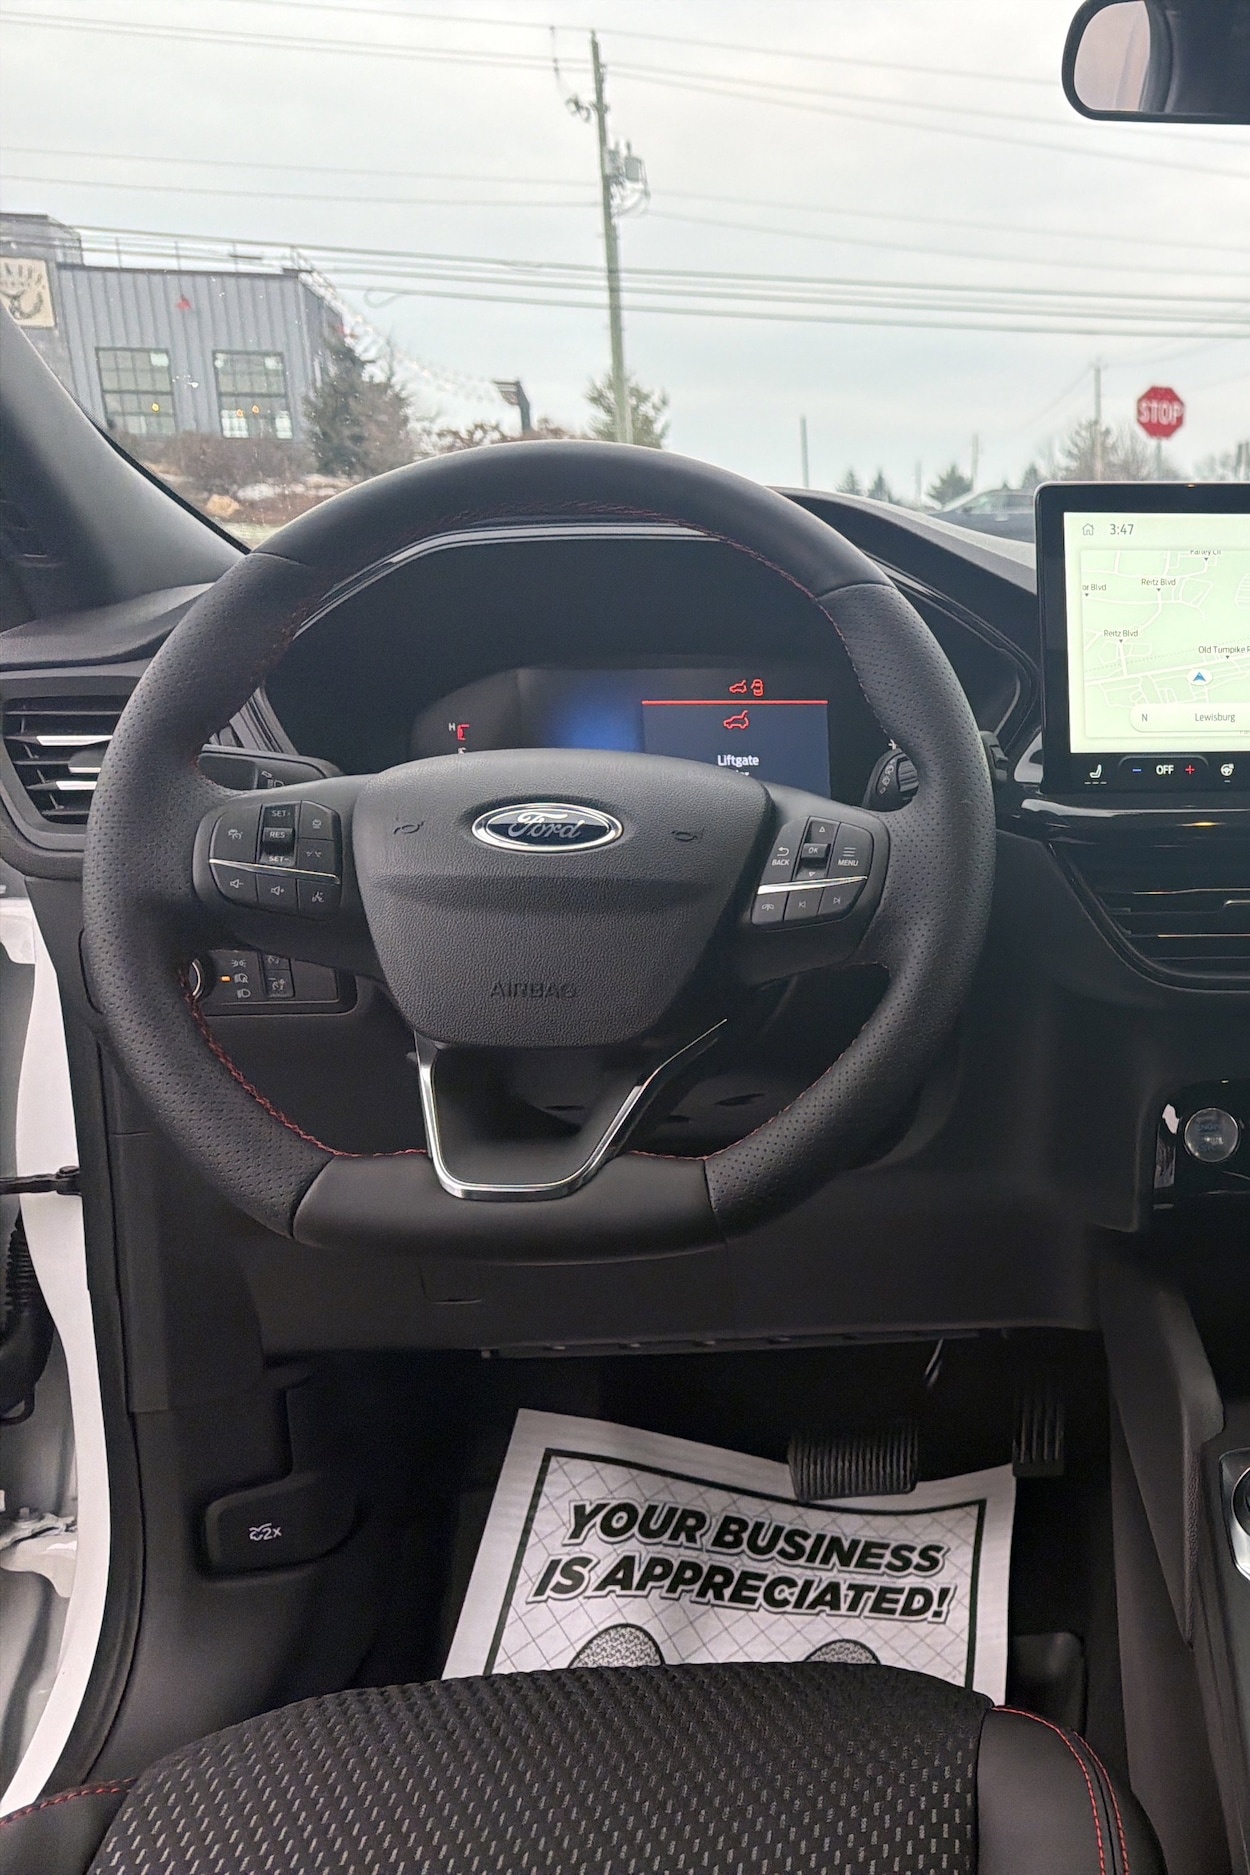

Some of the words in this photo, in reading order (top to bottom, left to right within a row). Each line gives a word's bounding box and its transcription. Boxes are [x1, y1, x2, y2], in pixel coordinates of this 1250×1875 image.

[1139, 400, 1184, 425] STOP
[1109, 523, 1134, 536] 3:47
[1090, 583, 1107, 591] Blvd
[1160, 578, 1176, 586] Blvd
[1122, 629, 1139, 637] Blvd
[1198, 646, 1212, 654] Old
[1212, 646, 1245, 656] Turnpike
[1141, 713, 1148, 722] N
[1194, 712, 1236, 723] Lewisburg
[717, 754, 760, 768] Liftgate
[1156, 764, 1174, 775] OFF
[508, 811, 585, 840] Ford
[269, 831, 286, 839] RES
[837, 859, 859, 867] MENU
[490, 982, 577, 999] AIRBAG
[566, 1500, 707, 1547] YOUR
[711, 1515, 948, 1576] BUSINESS
[530, 1556, 594, 1602] IS
[594, 1555, 957, 1623] APPRECIATED!
